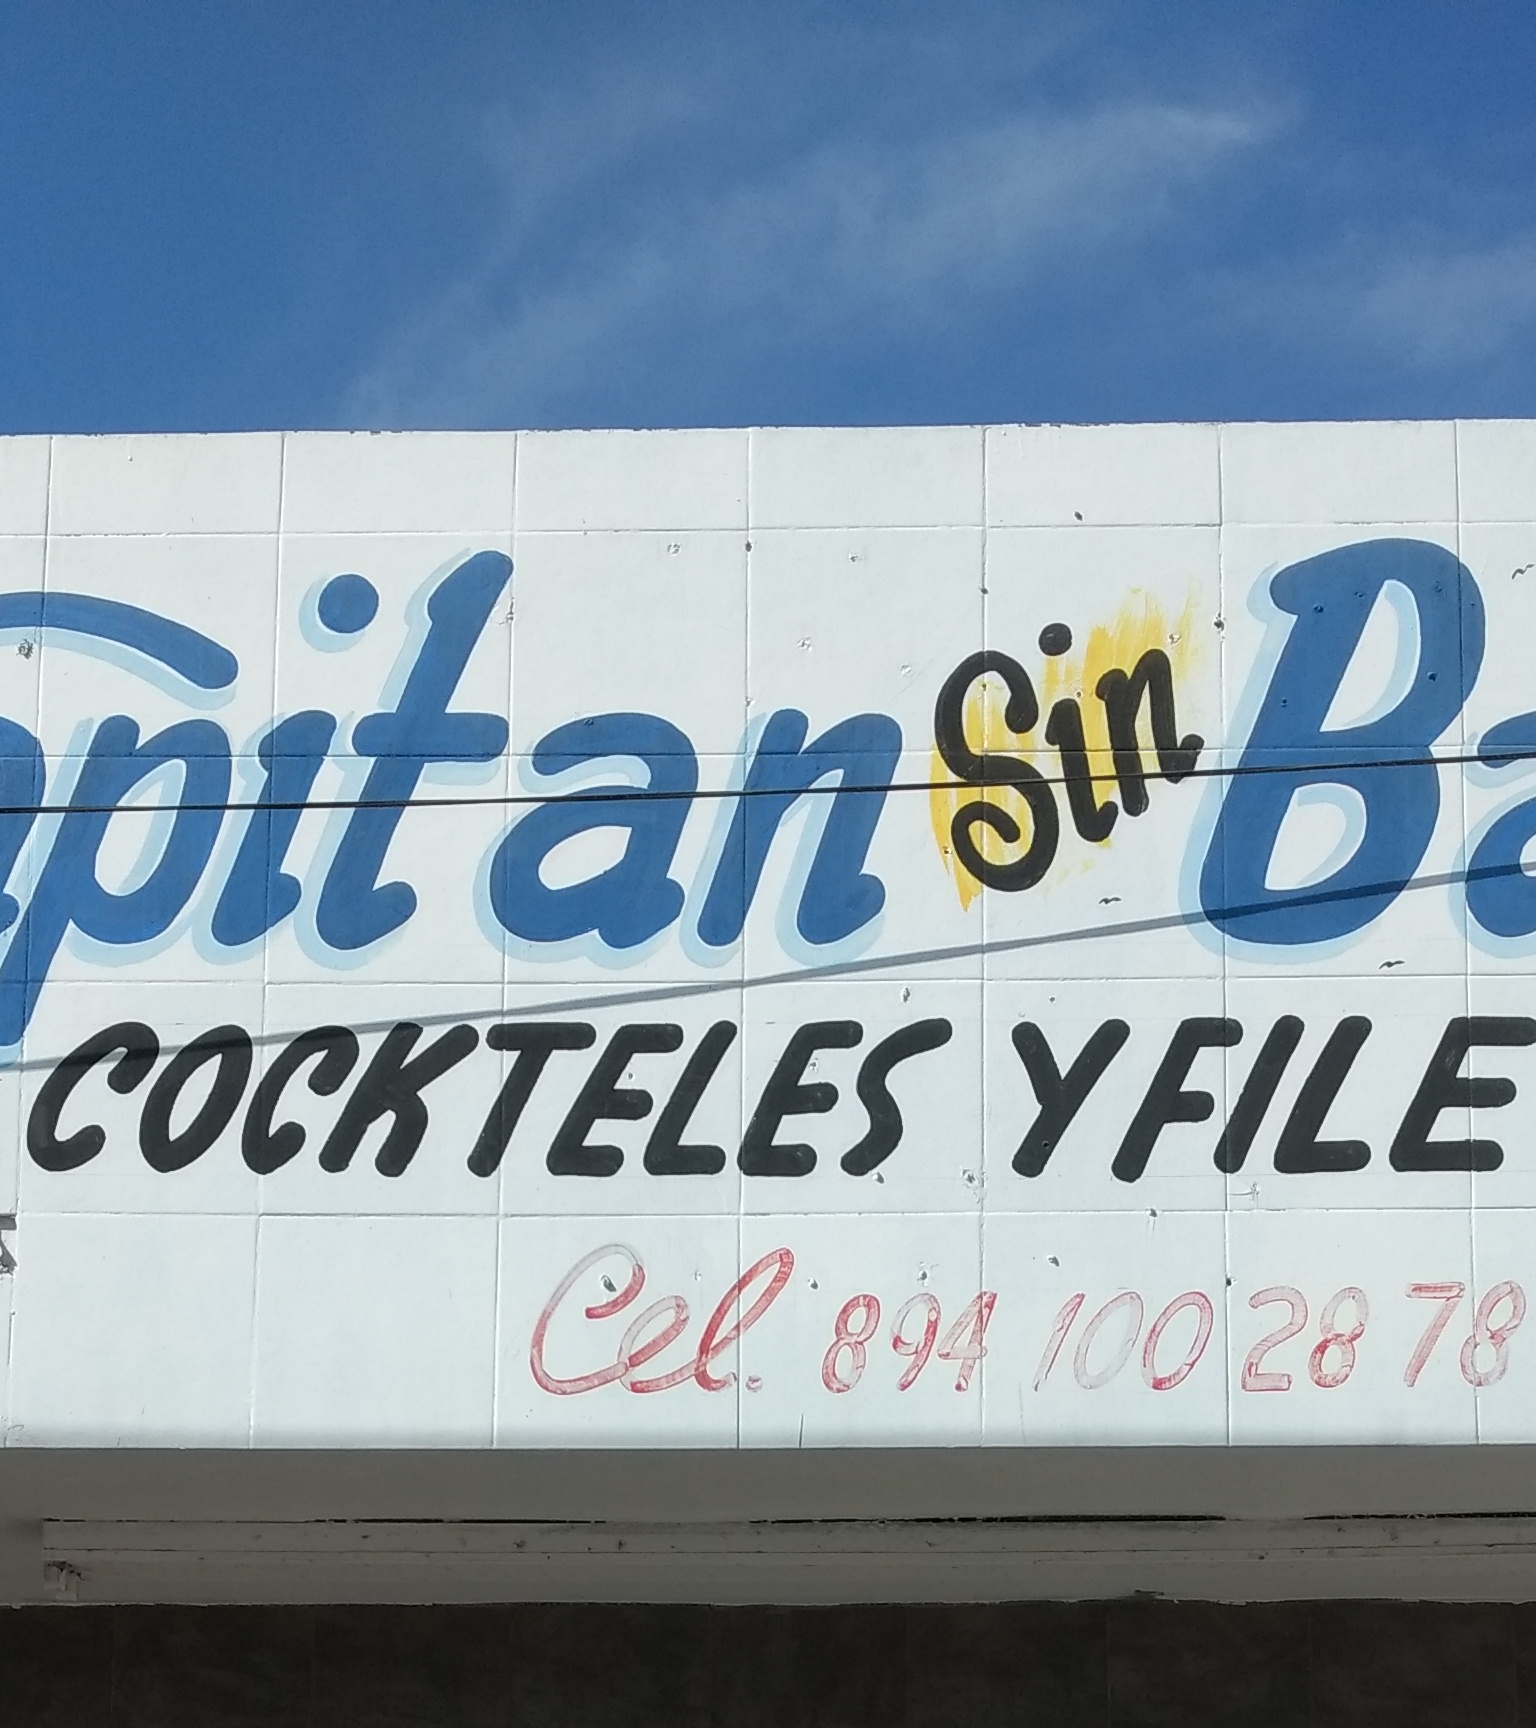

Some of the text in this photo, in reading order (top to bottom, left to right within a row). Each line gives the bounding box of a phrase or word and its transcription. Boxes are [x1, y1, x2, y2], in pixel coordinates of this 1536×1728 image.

[934, 622, 1205, 892] Sin
[26, 1018, 952, 1177] COCKTELES
[1009, 1017, 1132, 1178] Y
[529, 1242, 1528, 1396] Cel. 894 100 28 78
